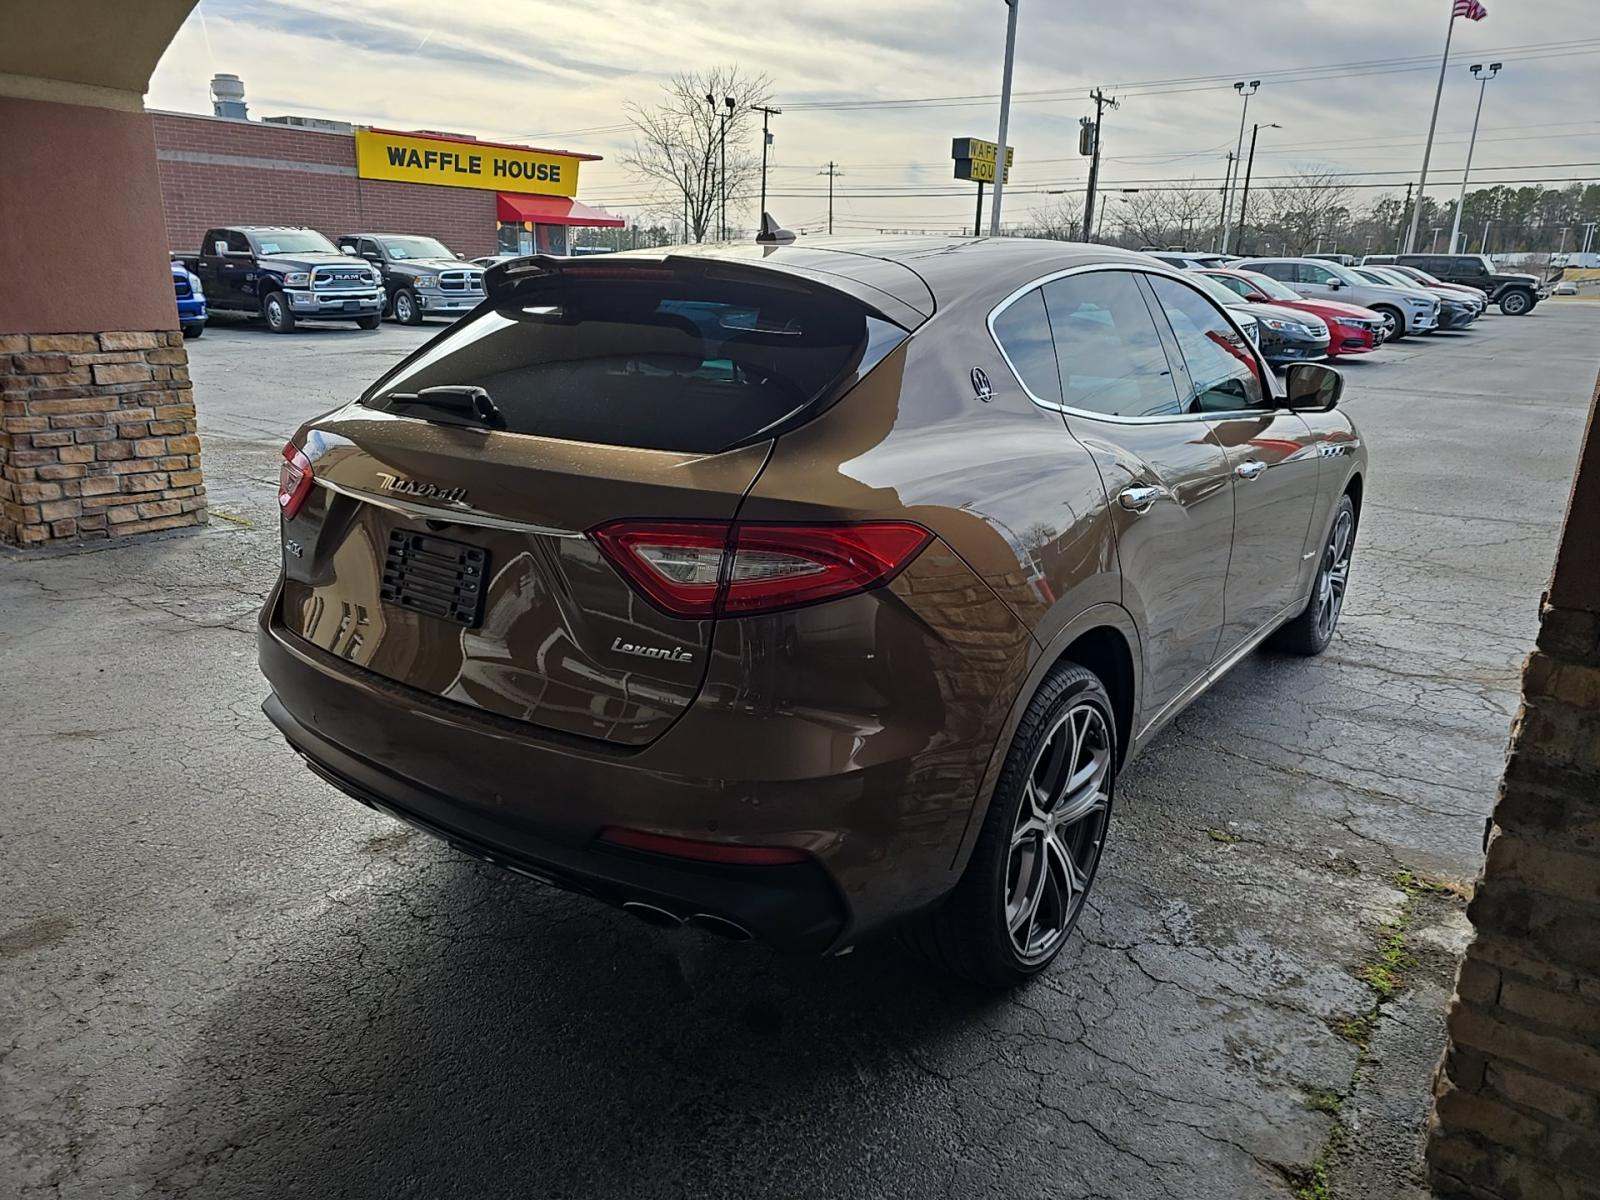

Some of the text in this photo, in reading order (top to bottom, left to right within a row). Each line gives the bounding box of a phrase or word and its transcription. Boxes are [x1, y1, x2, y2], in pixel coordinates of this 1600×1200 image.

[386, 146, 561, 183] WAFFLE HOUSE
[971, 141, 1013, 165] WAFFE
[611, 637, 693, 663] Levante
